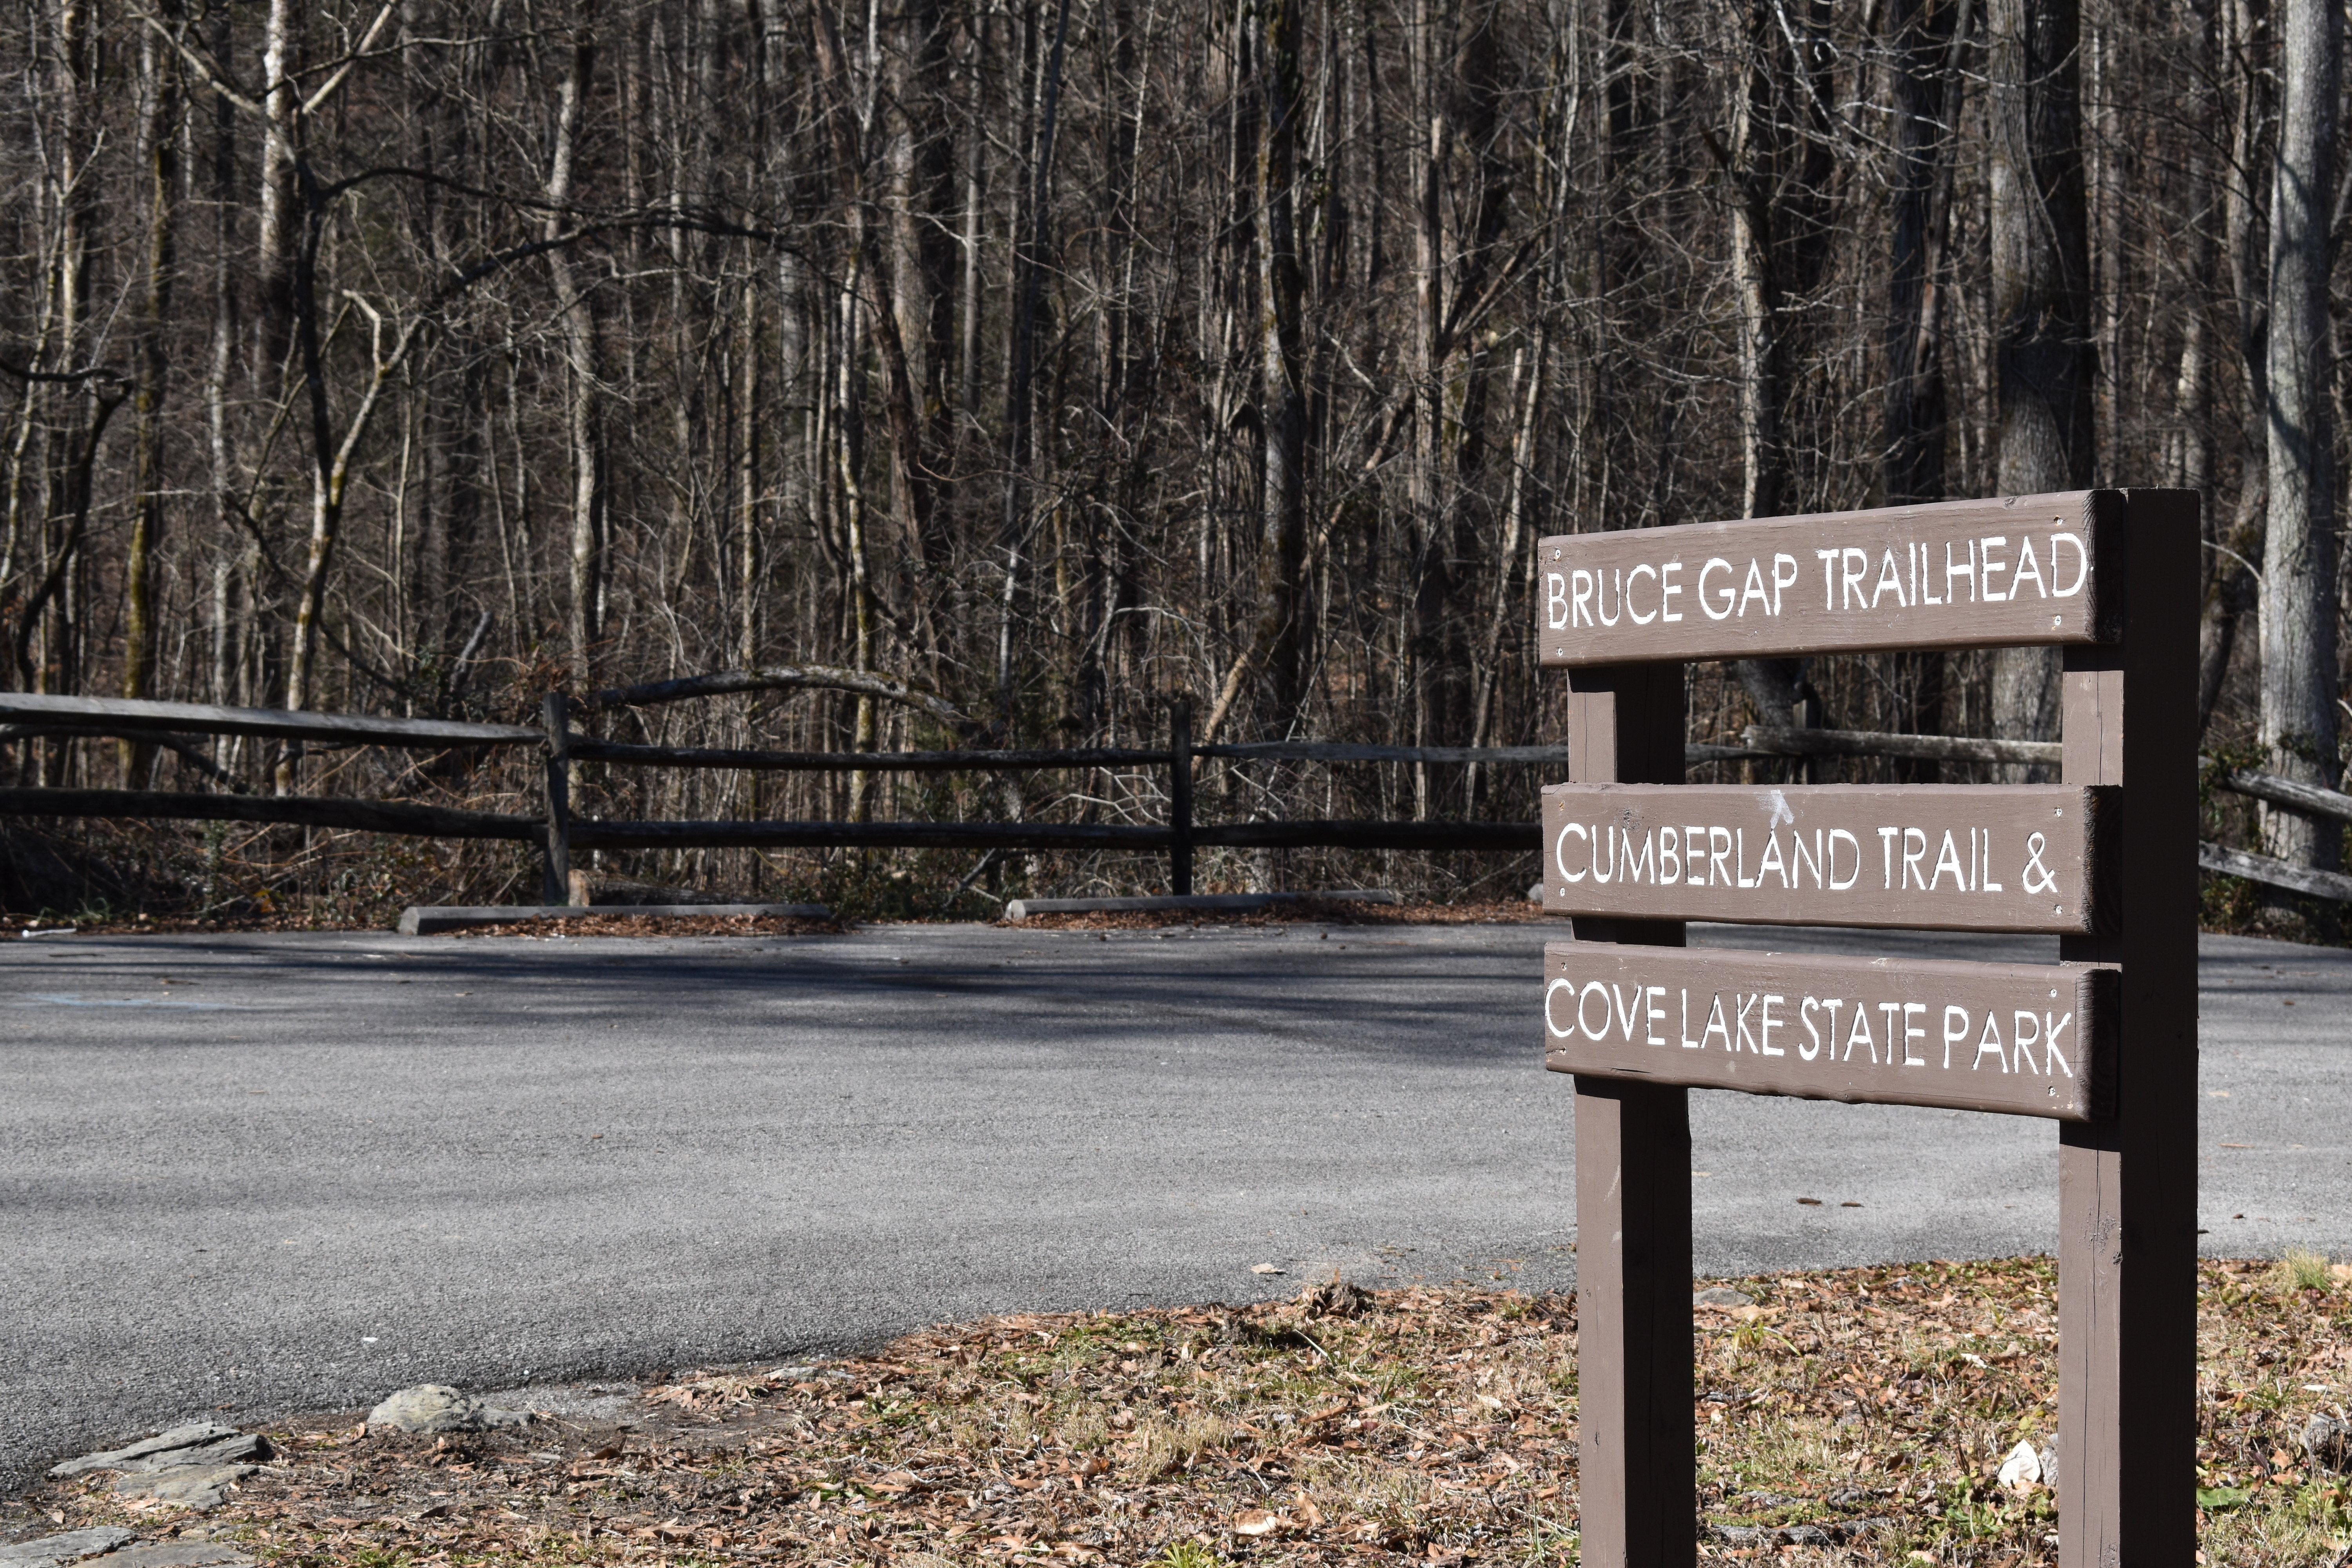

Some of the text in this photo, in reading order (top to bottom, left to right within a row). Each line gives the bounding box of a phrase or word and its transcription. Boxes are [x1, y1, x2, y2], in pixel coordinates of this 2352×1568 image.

[1547, 532, 2088, 629] BRUCE GAP TRAILHEAD
[1556, 822, 2058, 895] CUMBERLAND TRAIL &
[1545, 978, 2074, 1078] COVE LAKE STATE PARK
